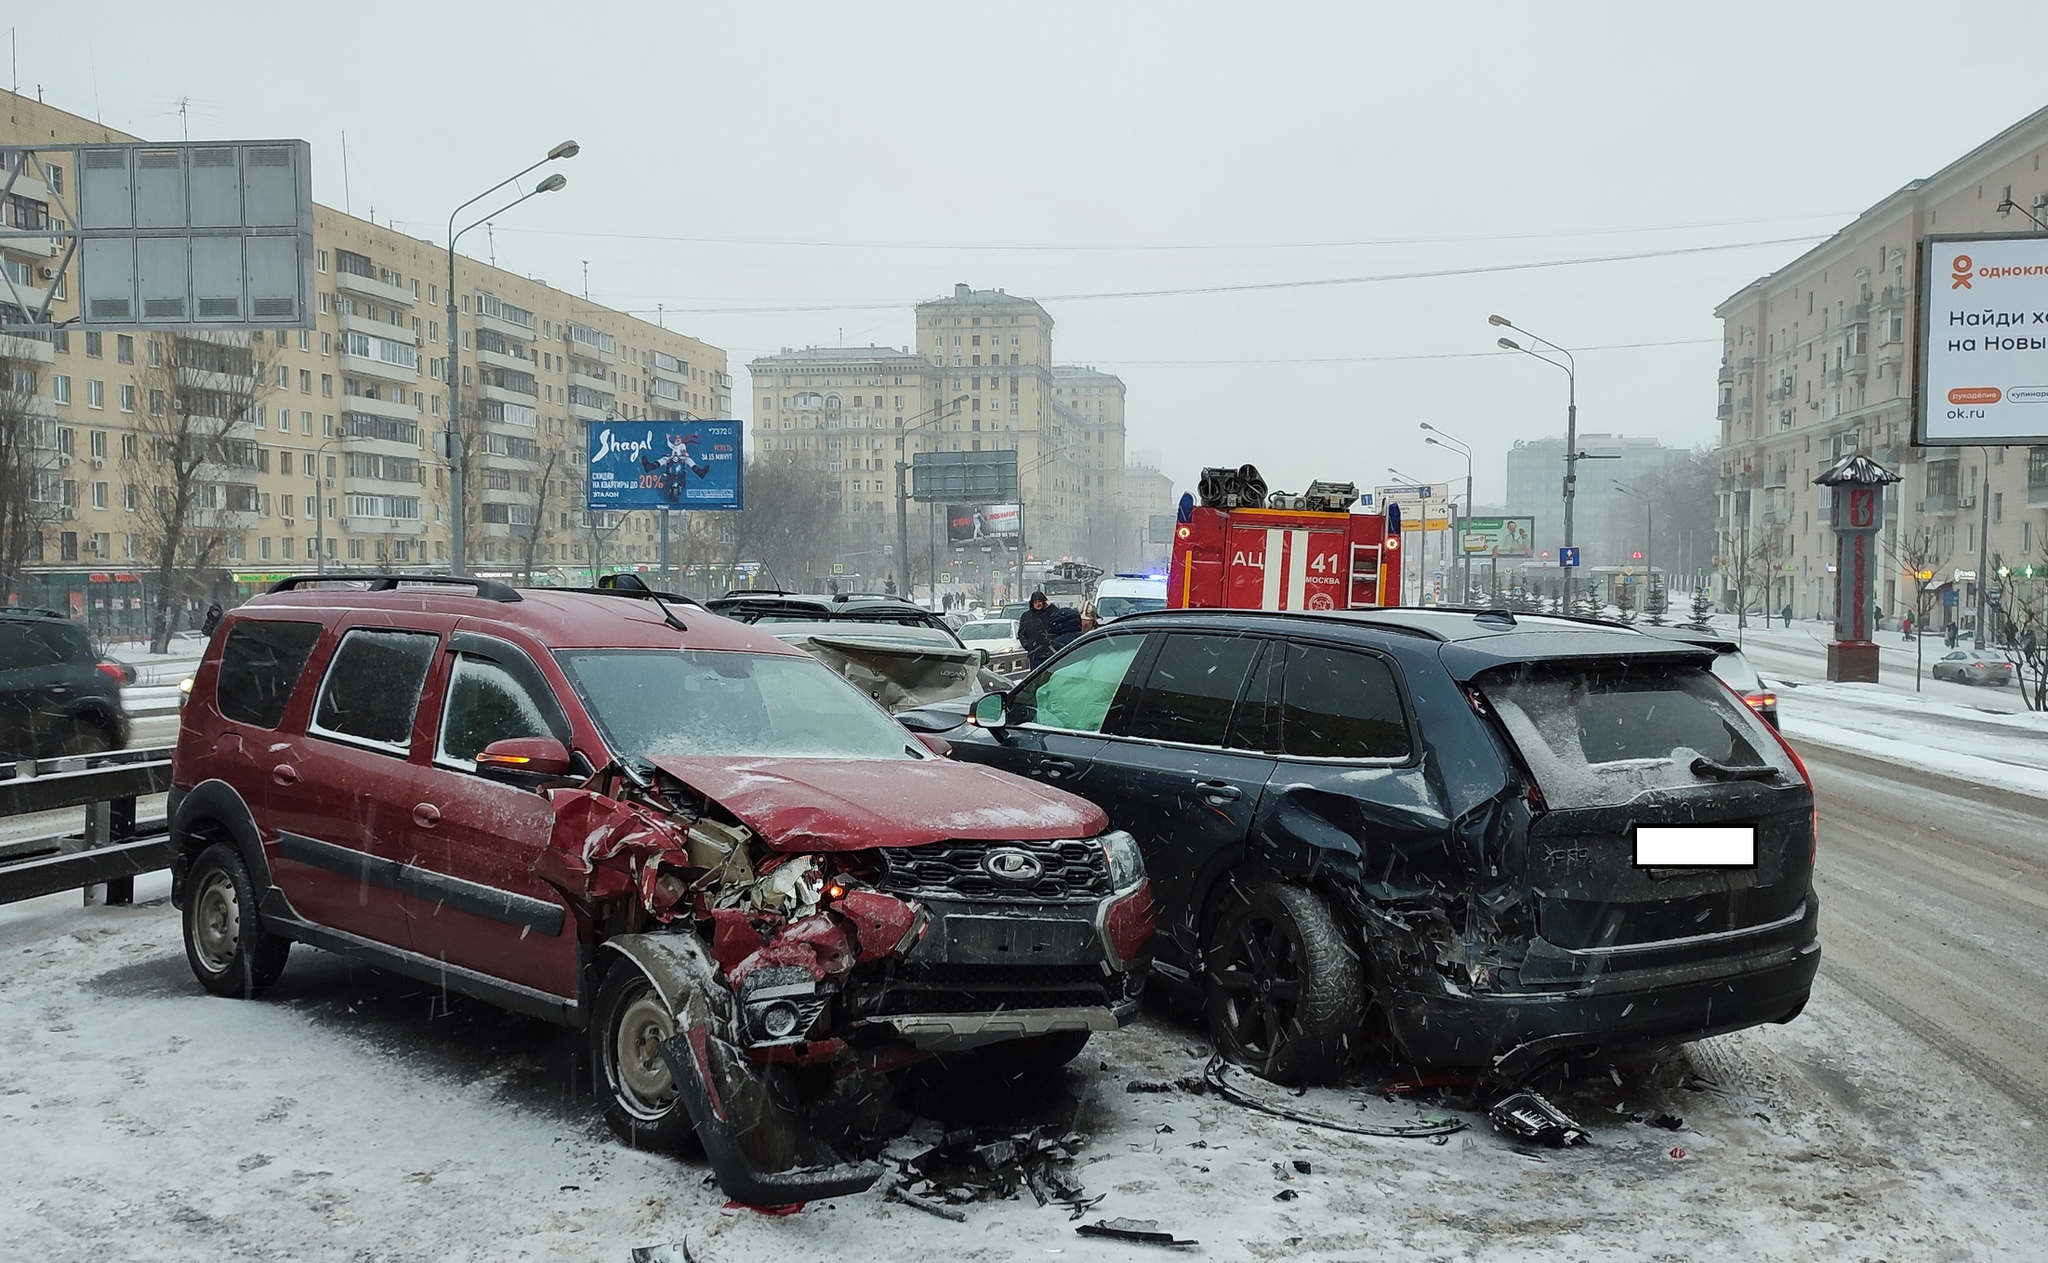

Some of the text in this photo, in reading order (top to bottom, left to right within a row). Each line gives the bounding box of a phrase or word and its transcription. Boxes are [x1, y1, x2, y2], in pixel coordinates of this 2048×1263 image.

[1949, 309, 2048, 328] Найди х
[1948, 339, 1976, 352] на
[1952, 392, 1997, 401] рукоделие
[1947, 408, 1985, 419] ok.ru
[592, 428, 653, 463] Shagal
[592, 472, 615, 480] СКИДКИ
[592, 474, 664, 489] НА КВАРТИРЫ ДО 20%
[1231, 551, 1263, 570] АЦ
[1311, 552, 1339, 574] 41
[1306, 576, 1340, 585] МОСКВА
